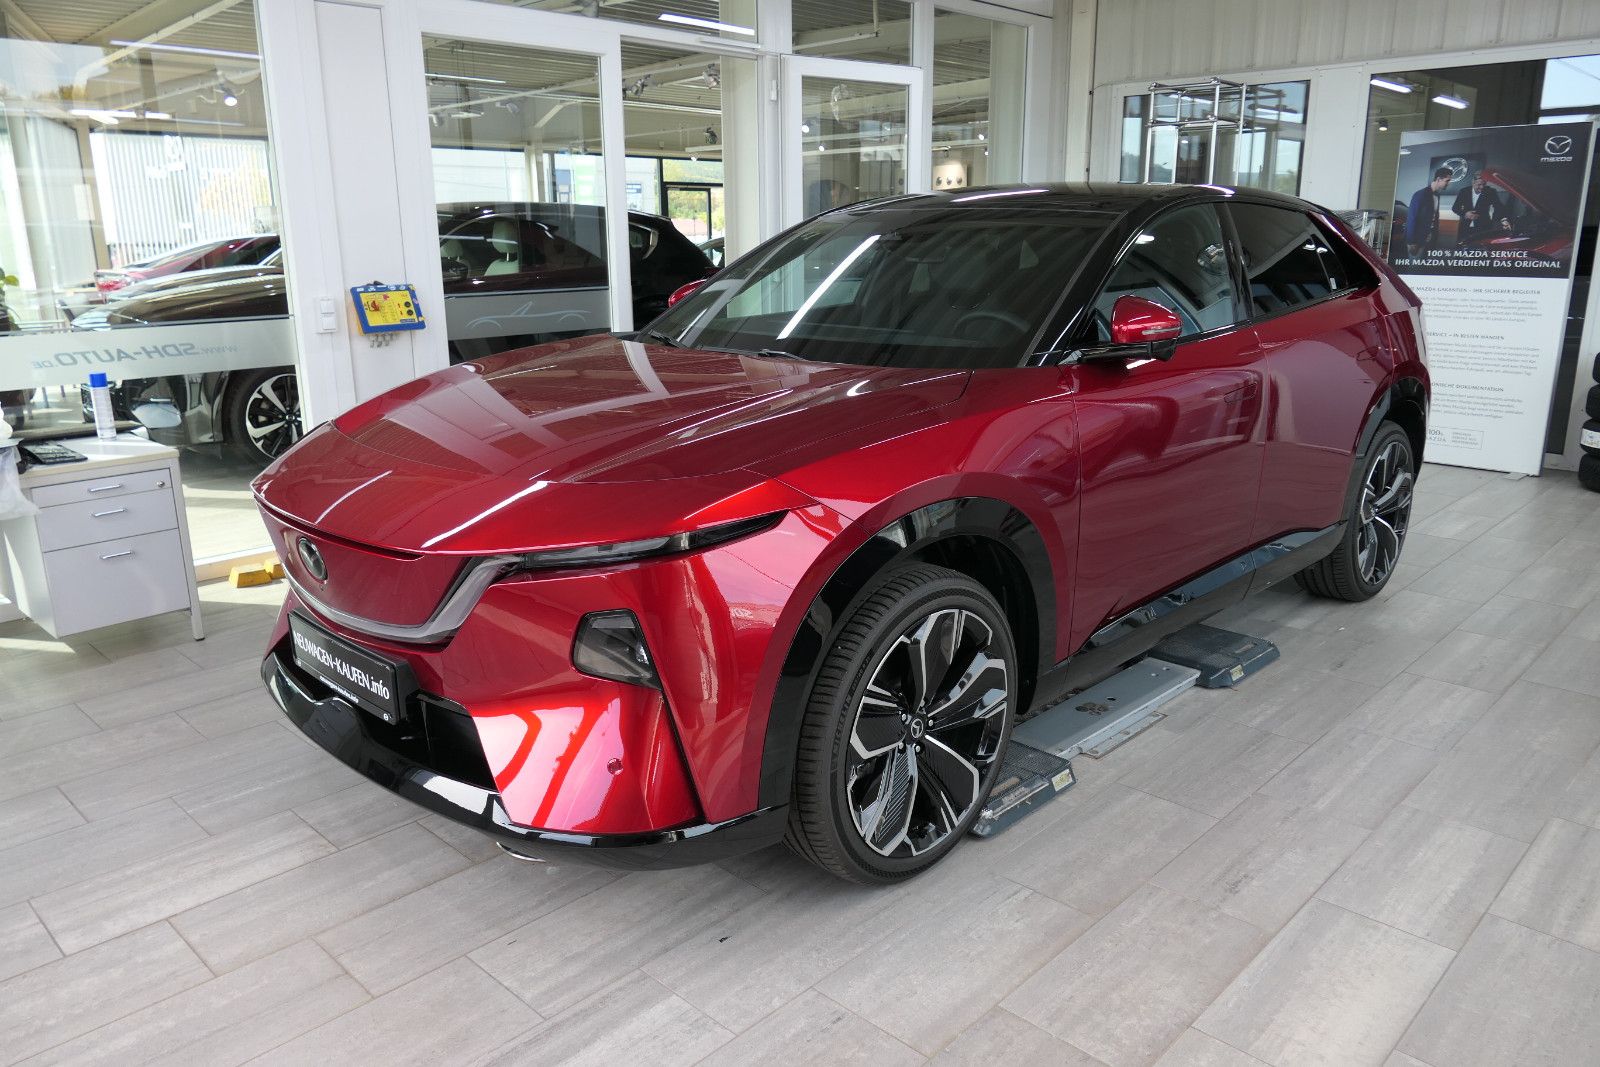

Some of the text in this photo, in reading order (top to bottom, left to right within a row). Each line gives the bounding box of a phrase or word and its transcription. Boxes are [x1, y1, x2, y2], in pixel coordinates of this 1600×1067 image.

[1453, 250, 1488, 258] MAZDA
[1490, 250, 1528, 258] SERVICE
[1395, 258, 1561, 269] IHR MAZDA VERDIENT DAS ORIGINAL
[293, 630, 390, 700] NEUWAGEN-KAUFEN.info
